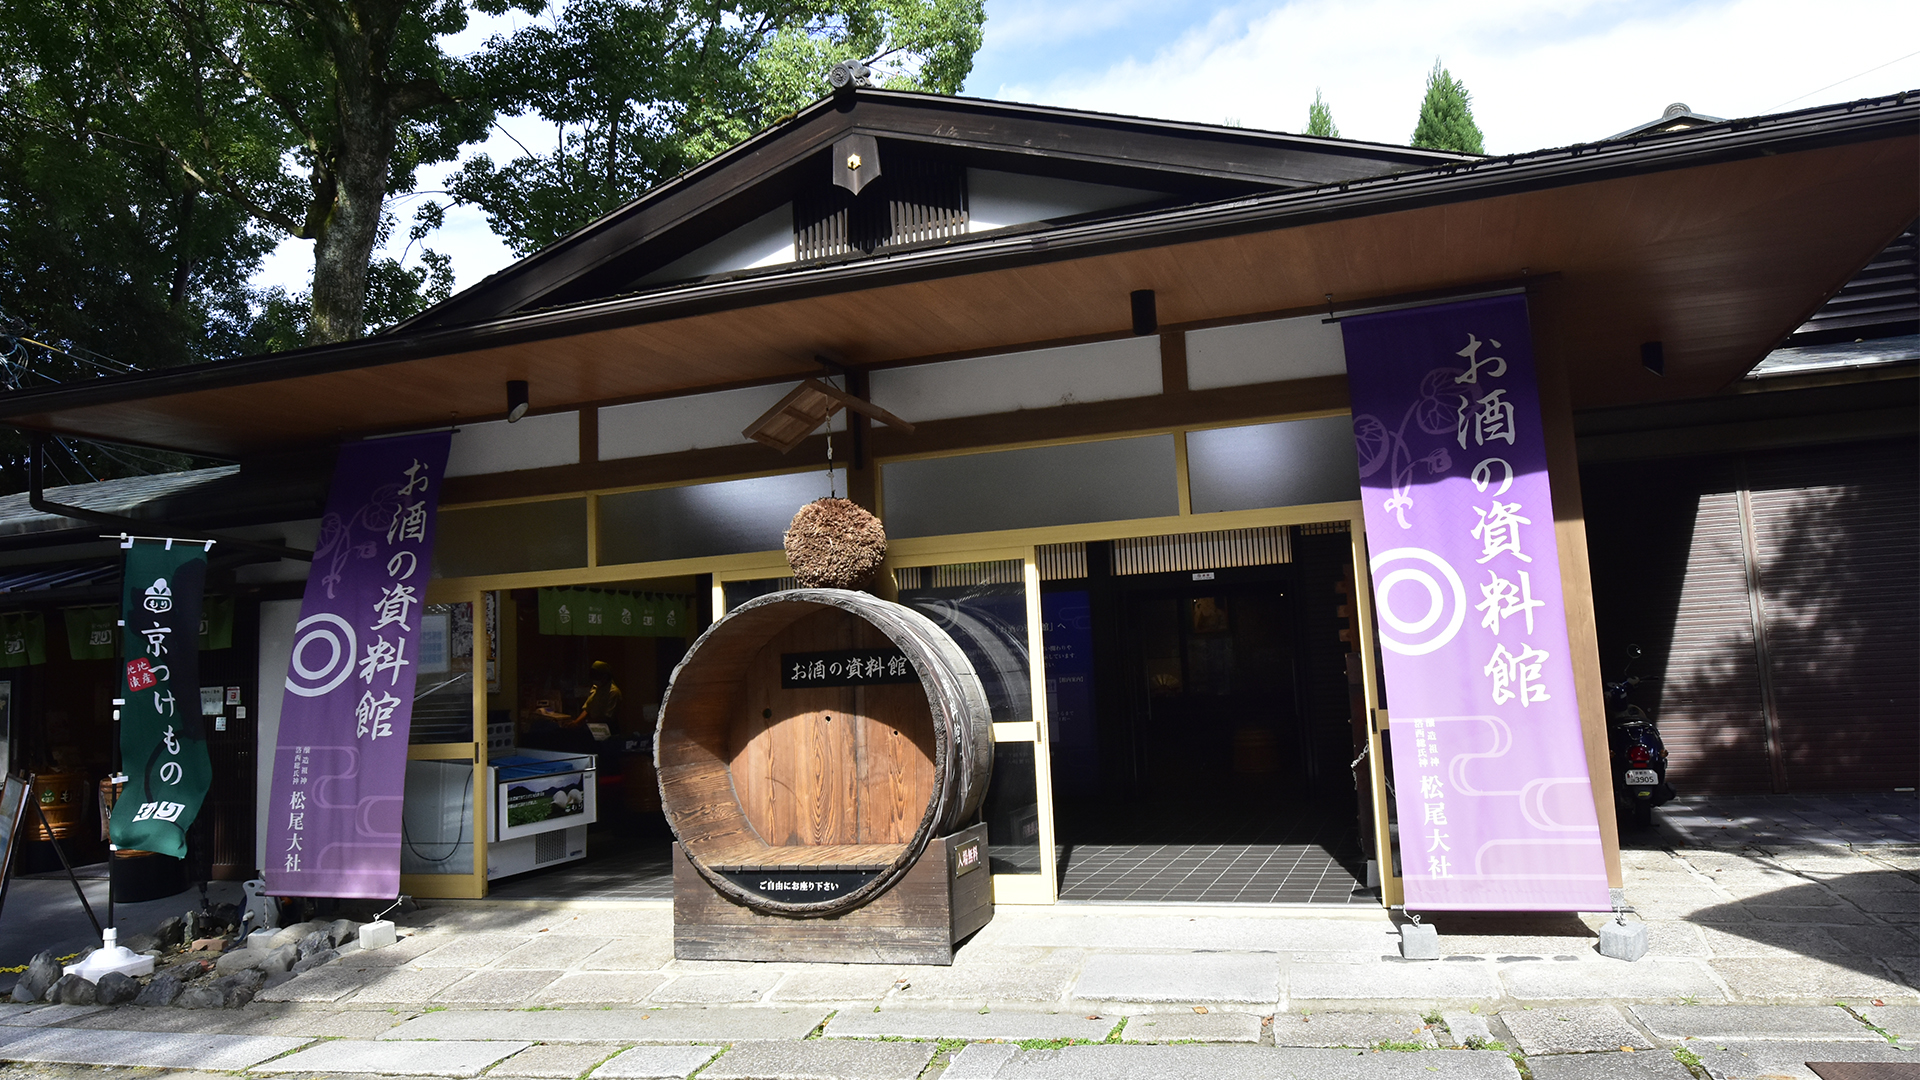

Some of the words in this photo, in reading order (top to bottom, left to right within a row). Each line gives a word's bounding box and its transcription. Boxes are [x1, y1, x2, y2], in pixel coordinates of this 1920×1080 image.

[1455, 332, 1551, 708] お酒の資料館
[355, 458, 428, 740] お酒の資料館
[137, 661, 153, 684] 地産
[141, 621, 183, 787] 京つけもの
[791, 655, 908, 681] お酒の資料館
[284, 790, 307, 873] 松尾大社
[957, 845, 978, 869] 入場無料
[1419, 774, 1454, 881] 松尾大社
[759, 880, 839, 891] ご自由にお座り下さい
